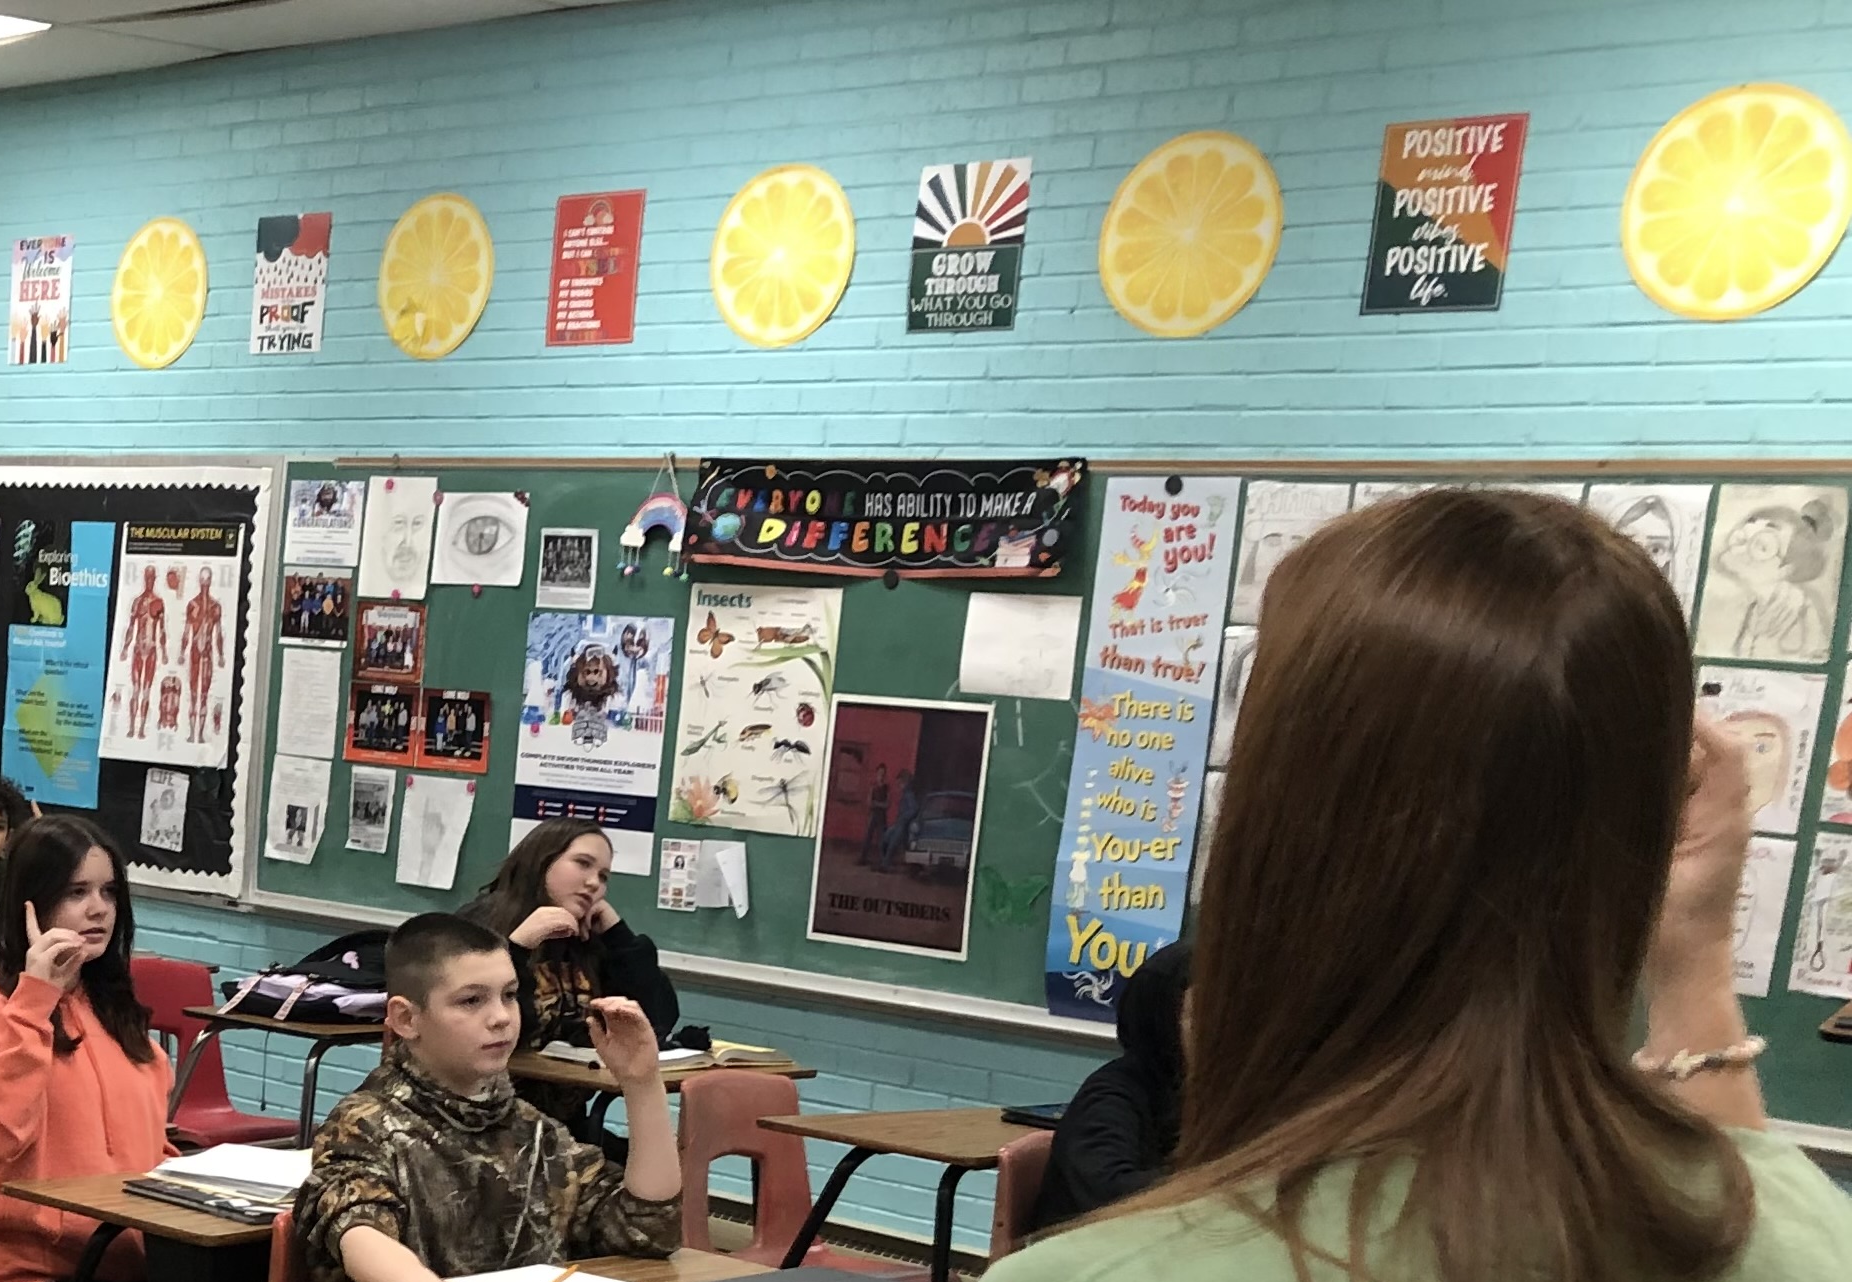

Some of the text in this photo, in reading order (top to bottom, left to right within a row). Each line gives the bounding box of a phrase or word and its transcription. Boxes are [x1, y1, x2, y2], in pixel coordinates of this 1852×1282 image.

[1402, 122, 1508, 159] POSITIVE
[1392, 183, 1498, 218] POSITIVE
[20, 237, 66, 250] EVERYONE
[44, 250, 55, 264] IS
[932, 251, 996, 276] GROW
[1384, 243, 1488, 276] POSITIVE
[19, 279, 61, 302] HERE
[261, 286, 317, 299] MISTAKES
[925, 274, 1001, 296] THROUGH
[259, 301, 315, 324] PROOF
[911, 293, 1013, 312] WHAT YOU GO
[925, 311, 993, 327] THROUGH
[257, 333, 314, 352] TRYING
[865, 492, 892, 517] HAS
[897, 493, 953, 517] ABILITY
[958, 493, 977, 517] TO
[980, 492, 1022, 518] MAKE
[1022, 491, 1036, 514] A
[1120, 494, 1200, 521] Today you
[129, 527, 224, 541] THE MUSCULAR SYSTEM
[757, 518, 997, 555] DIFFERENCE
[1163, 523, 1197, 543] are
[38, 549, 78, 567] Exploring
[1163, 533, 1216, 574] you!
[49, 567, 108, 588] Bioethics
[697, 589, 752, 608] Insects
[1109, 613, 1209, 640] That is truer
[1099, 644, 1207, 684] than true!
[1111, 690, 1194, 723] There is
[1105, 725, 1175, 752] no one
[1108, 756, 1155, 786] alive
[1096, 787, 1158, 822] who is
[1090, 832, 1181, 863] You-er
[1099, 873, 1165, 911] than
[828, 893, 951, 922] THE OUTSIDERS
